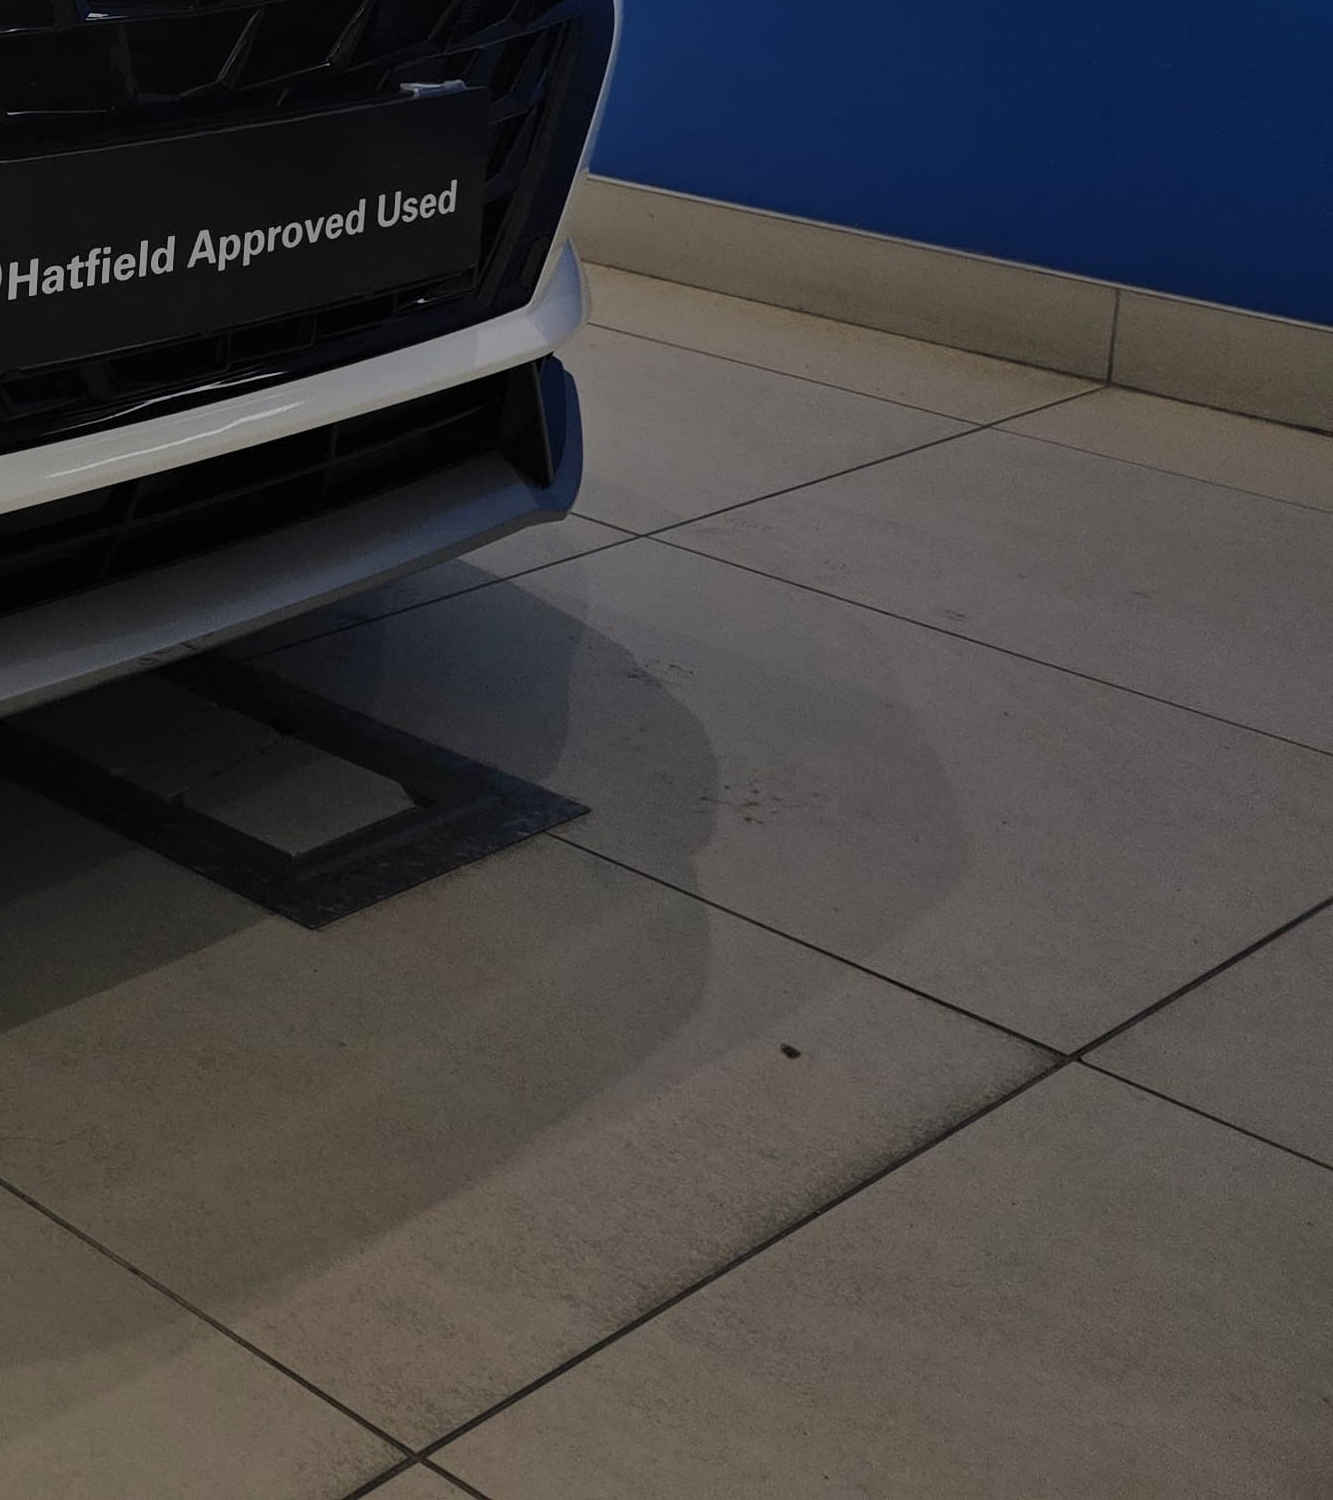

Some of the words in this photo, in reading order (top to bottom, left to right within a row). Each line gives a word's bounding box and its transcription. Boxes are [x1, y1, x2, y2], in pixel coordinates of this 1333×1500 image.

[7, 235, 176, 301] Hatfield
[186, 198, 367, 272] Approved
[377, 179, 458, 228] Used
